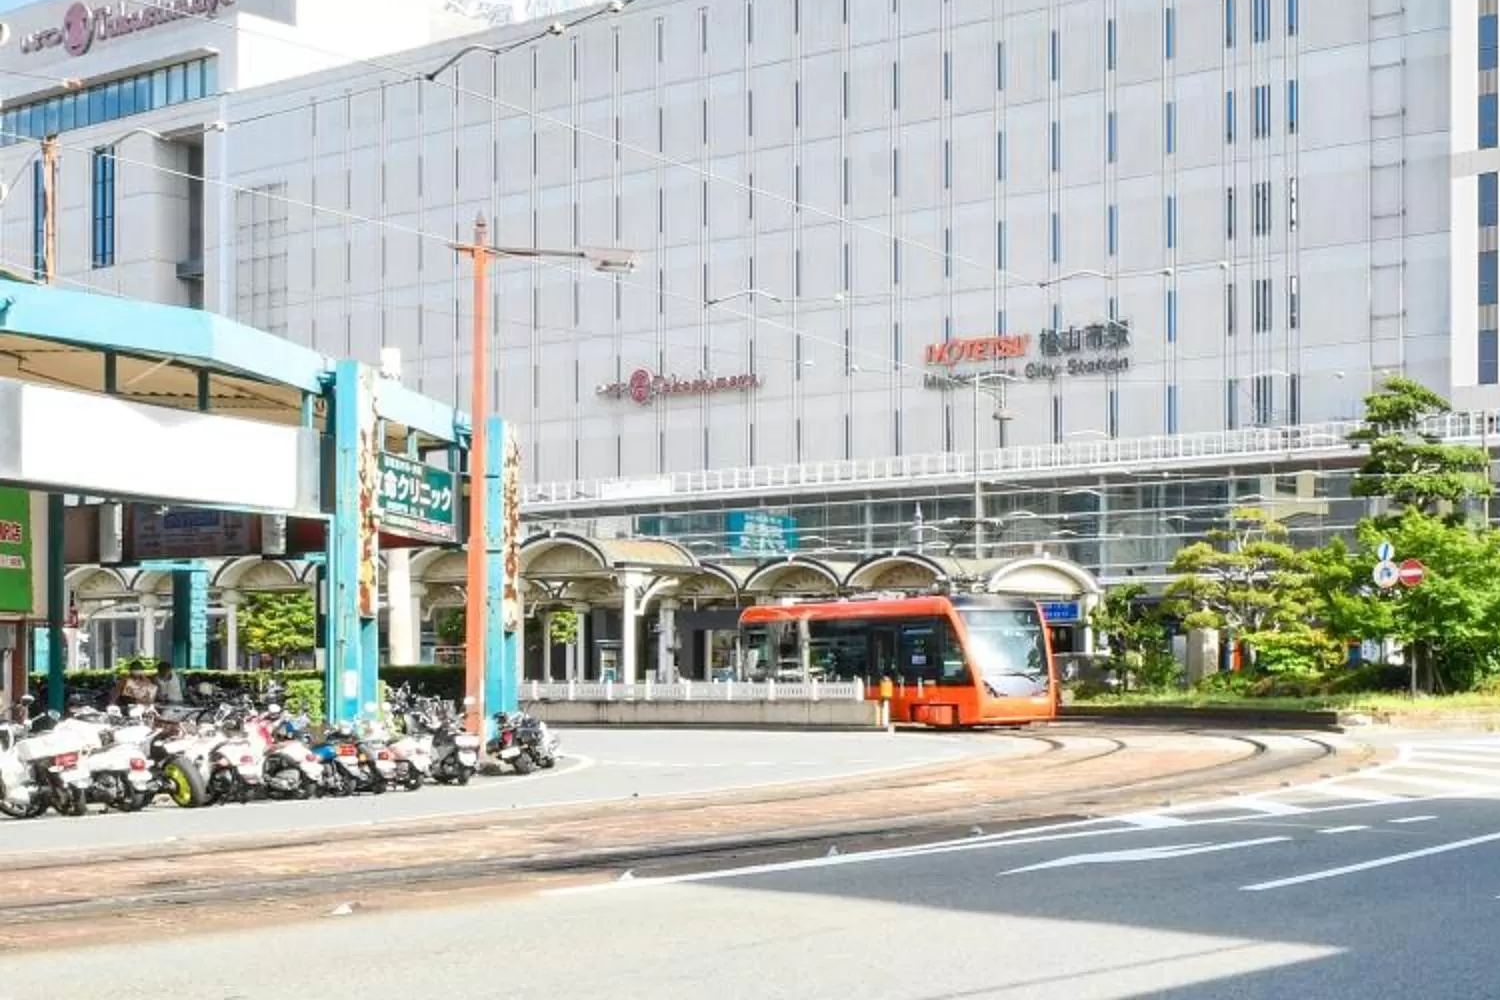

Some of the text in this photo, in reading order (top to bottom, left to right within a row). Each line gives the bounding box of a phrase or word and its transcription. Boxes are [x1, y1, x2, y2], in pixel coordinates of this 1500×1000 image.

[925, 334, 1030, 369] IYOTETSU
[1025, 361, 1061, 380] City
[1067, 357, 1129, 375] Station
